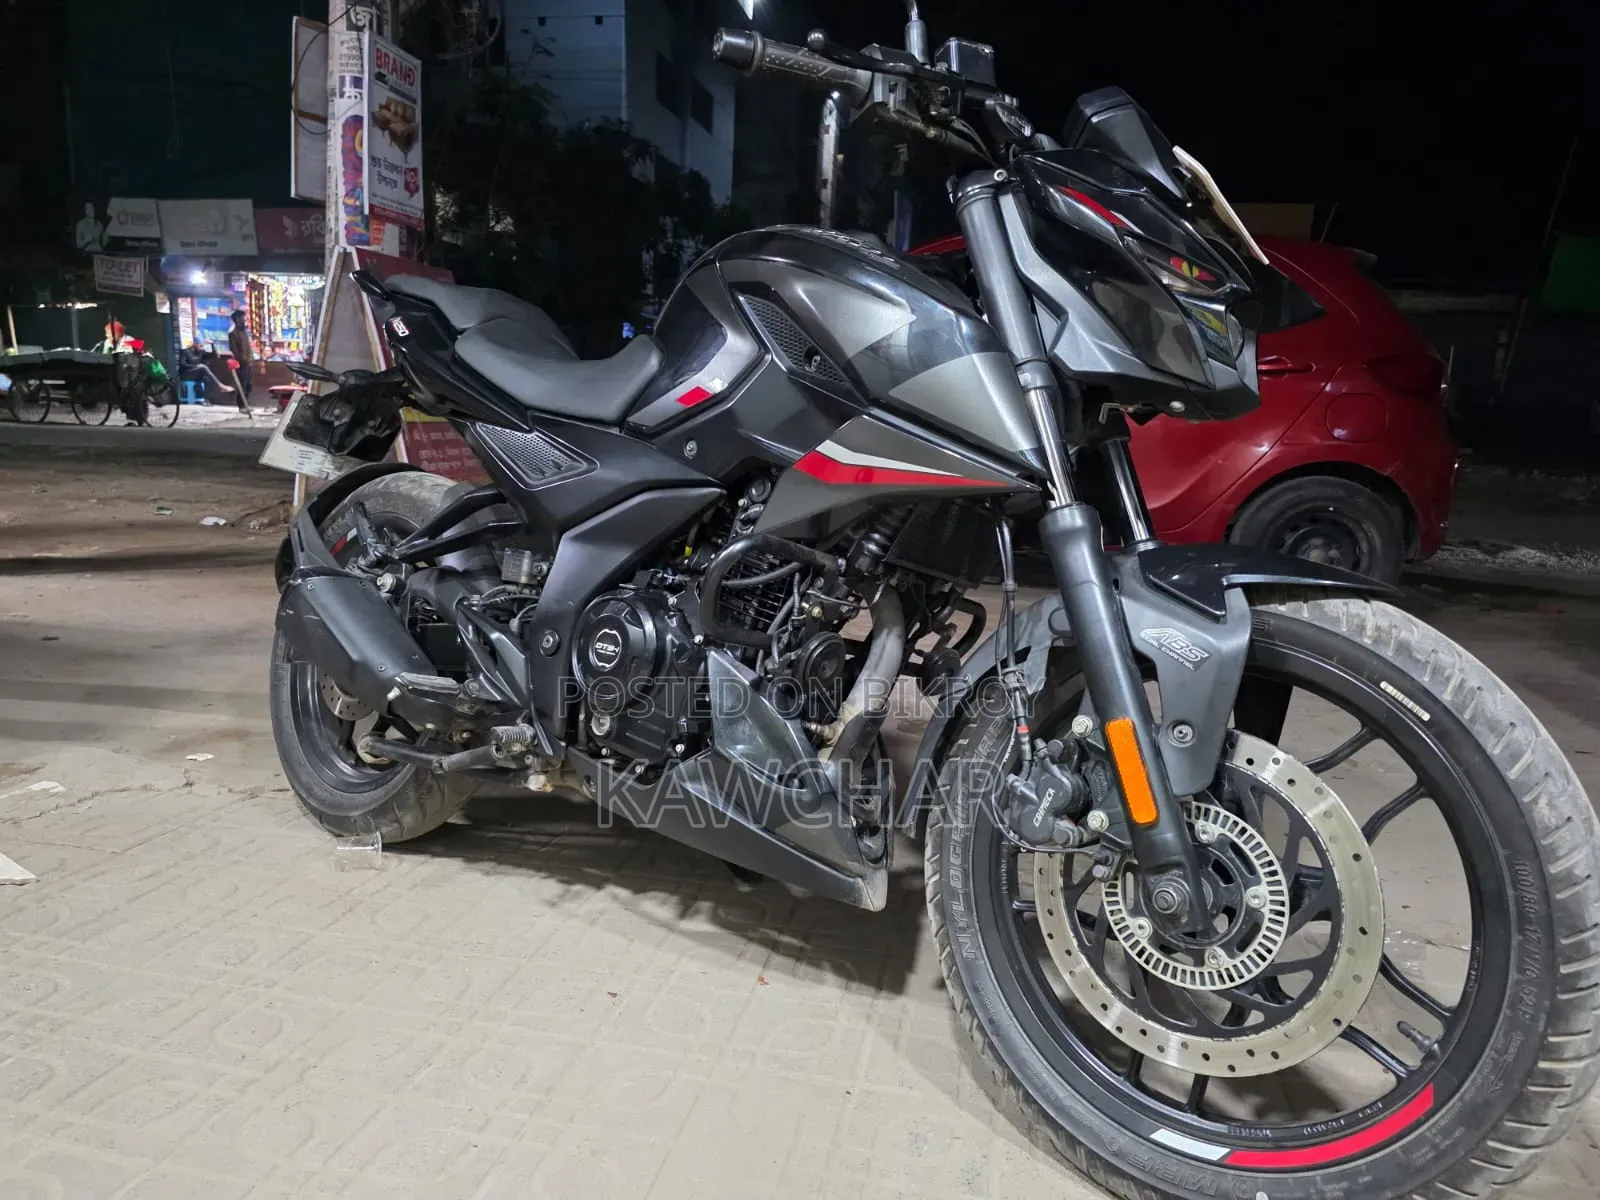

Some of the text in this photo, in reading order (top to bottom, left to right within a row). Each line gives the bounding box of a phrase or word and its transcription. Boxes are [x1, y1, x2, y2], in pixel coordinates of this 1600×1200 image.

[376, 47, 416, 88] BRAND
[1139, 627, 1210, 662] ABS
[1032, 787, 1056, 828] GRIMECA
